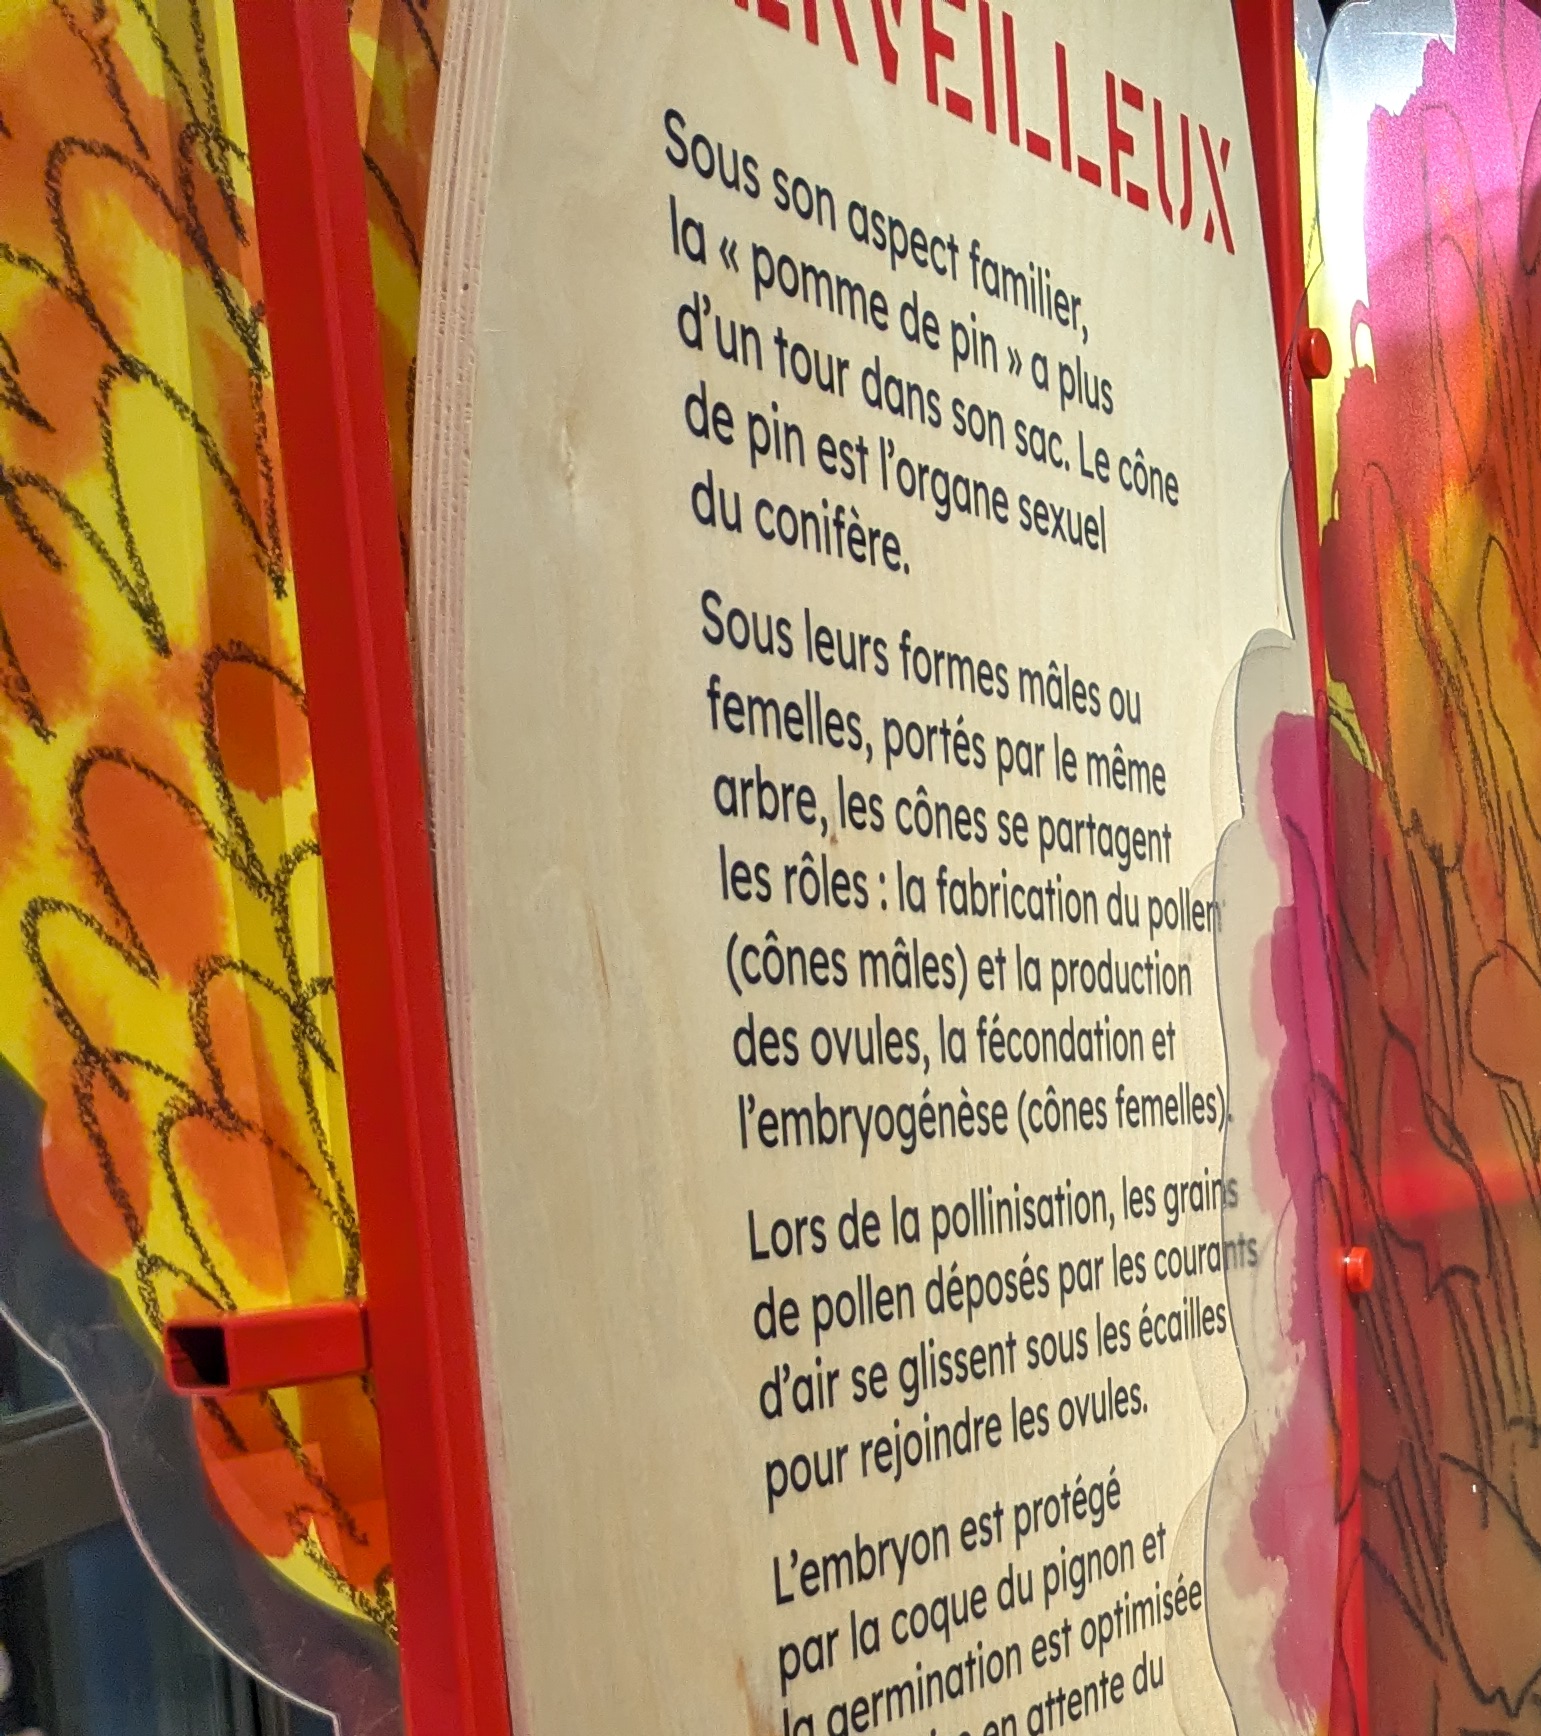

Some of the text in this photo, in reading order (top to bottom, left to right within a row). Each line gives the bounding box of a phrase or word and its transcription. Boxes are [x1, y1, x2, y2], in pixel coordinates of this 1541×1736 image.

[734, 0, 1235, 255] VEILLEUX
[663, 108, 1089, 345] Sous son aspect familier,
[669, 193, 707, 266] la
[751, 242, 889, 332] pomme
[899, 289, 941, 351] de
[950, 311, 999, 373] pin
[1031, 352, 1050, 392] a
[1058, 354, 1114, 416] plus
[677, 290, 1179, 507] d’un tour dans son sac. Le cône
[684, 379, 1107, 554] de pin est l’organe sexuel
[691, 468, 910, 576] du conifère.
[700, 588, 1142, 725] Sous leurs formes mâles ou
[706, 673, 1167, 797] femelles, portés par le même
[714, 764, 1172, 873] arbre, les cônes se partagent
[718, 843, 772, 903] les
[783, 850, 869, 910] rôles
[896, 859, 927, 914] la
[935, 864, 1099, 925] fabrication
[1106, 880, 1140, 927] du
[1148, 886, 1222, 942] pollen
[726, 929, 1192, 1006] (cônes mâles) et la production
[732, 1011, 1176, 1076] des ovules, la fécondation et
[738, 1081, 1233, 1159] l’embryogénèse (cônes femelles).
[747, 1166, 1239, 1262] Lors de la pollinisation, les grains
[753, 1231, 1258, 1348] de pollen déposés par les courants
[759, 1295, 1228, 1421] d’air se glissent sous les écailles
[765, 1376, 1148, 1515] pour rejoindre les ovules.
[772, 1464, 1121, 1606] L’embryon est protégé
[778, 1521, 1167, 1698] par la coque du pignon et
[1031, 1617, 1072, 1669] est
[1080, 1572, 1202, 1658] optimisée
[1132, 1650, 1164, 1696] du
